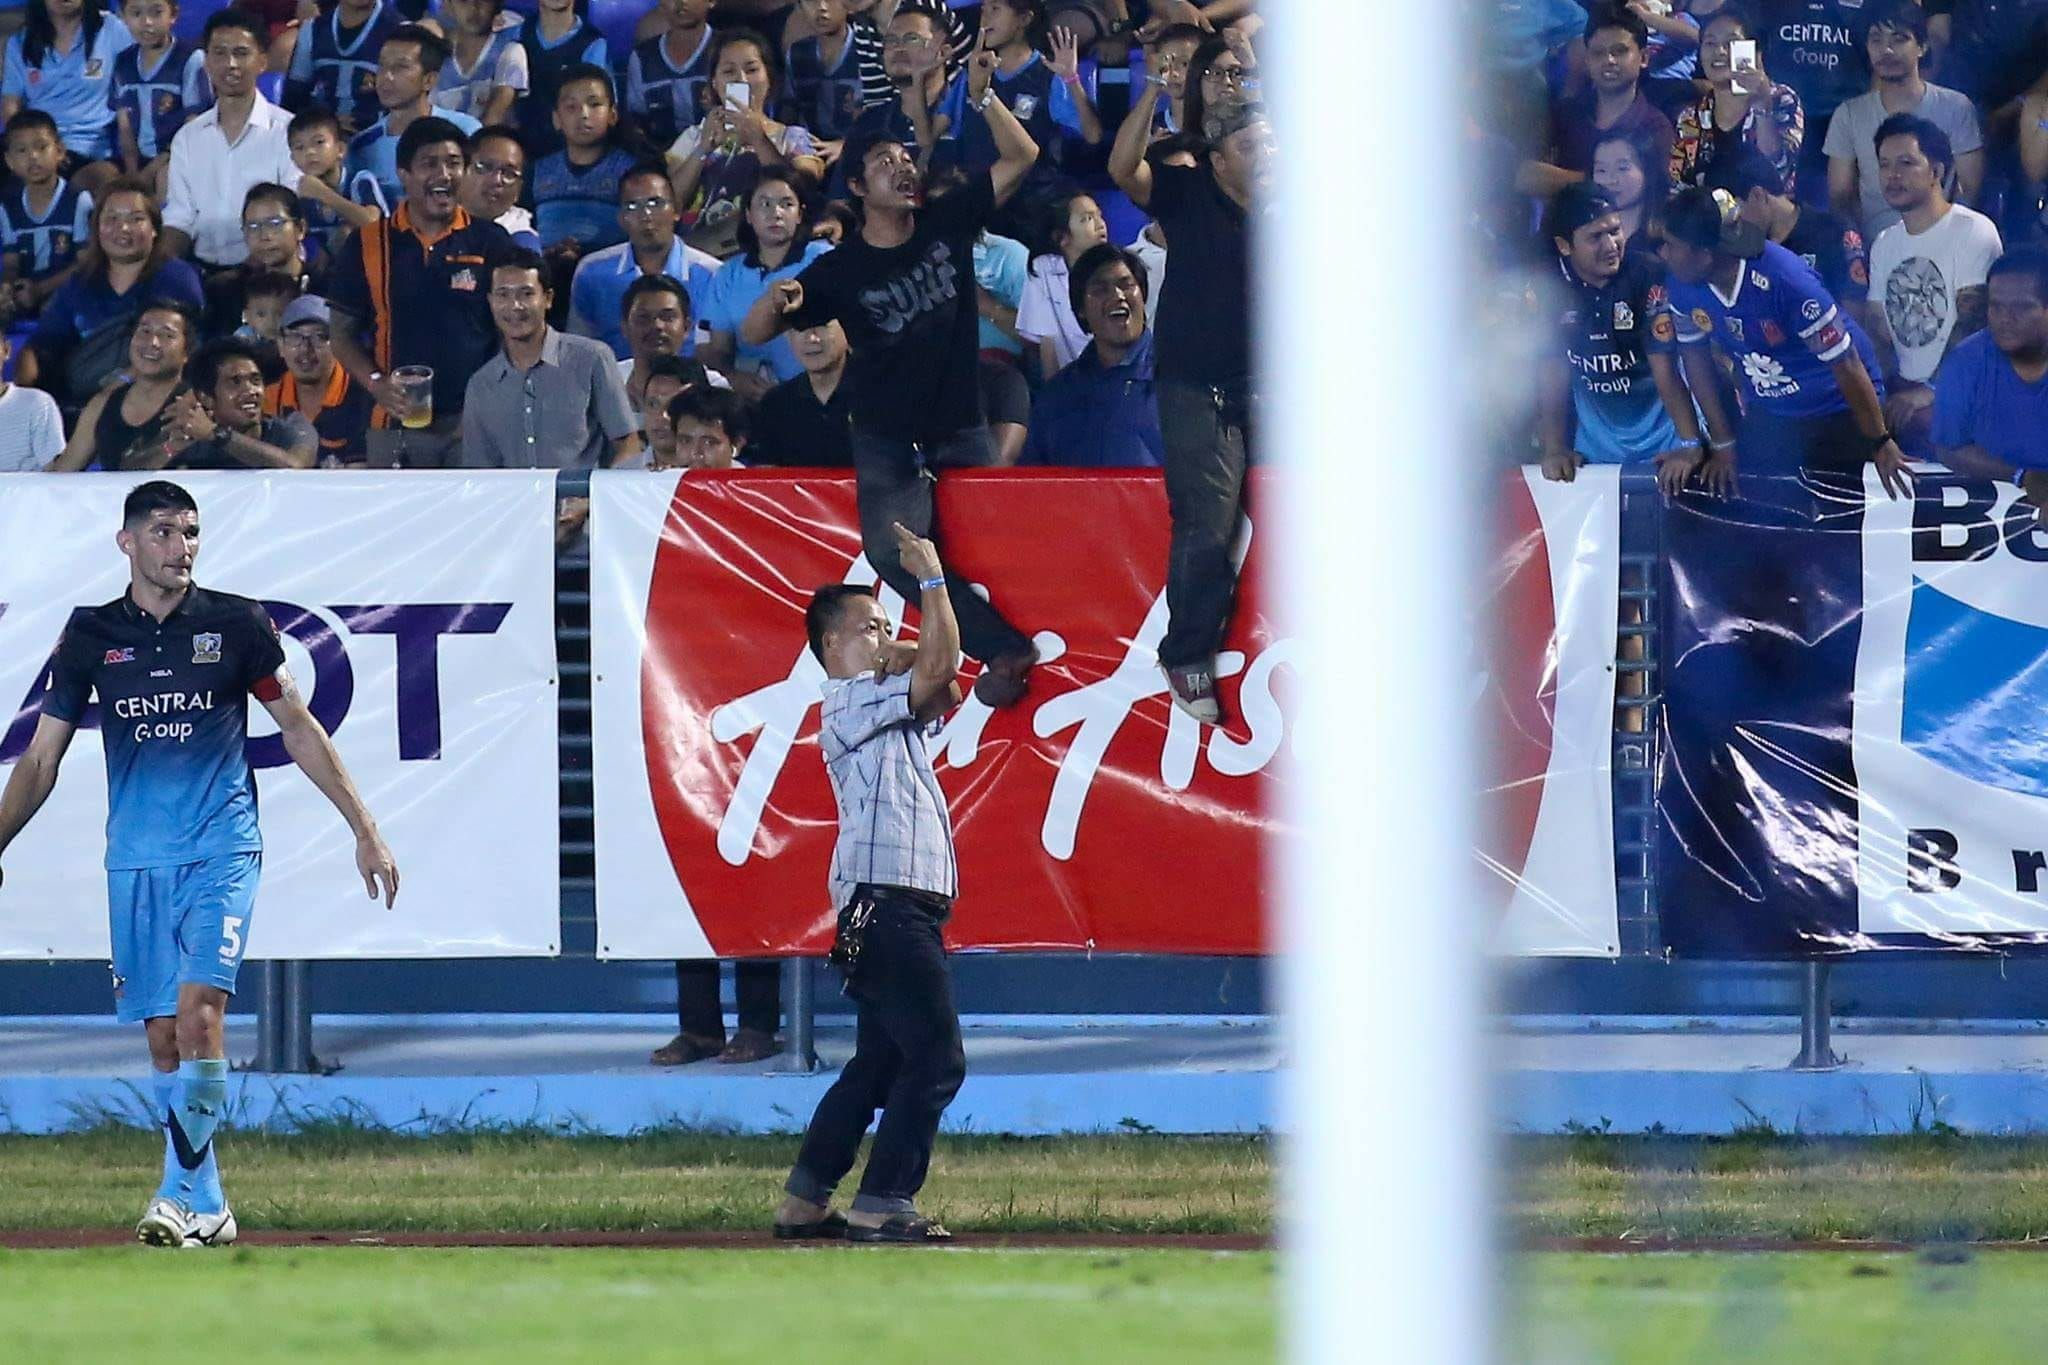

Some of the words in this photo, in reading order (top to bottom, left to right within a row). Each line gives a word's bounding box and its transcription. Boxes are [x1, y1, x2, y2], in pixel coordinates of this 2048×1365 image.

[1780, 24, 1852, 46] CENTRAL
[860, 241, 957, 333] SURF
[115, 691, 215, 719] CENTRAL
[134, 722, 193, 743] Goup
[218, 915, 243, 958] 5
